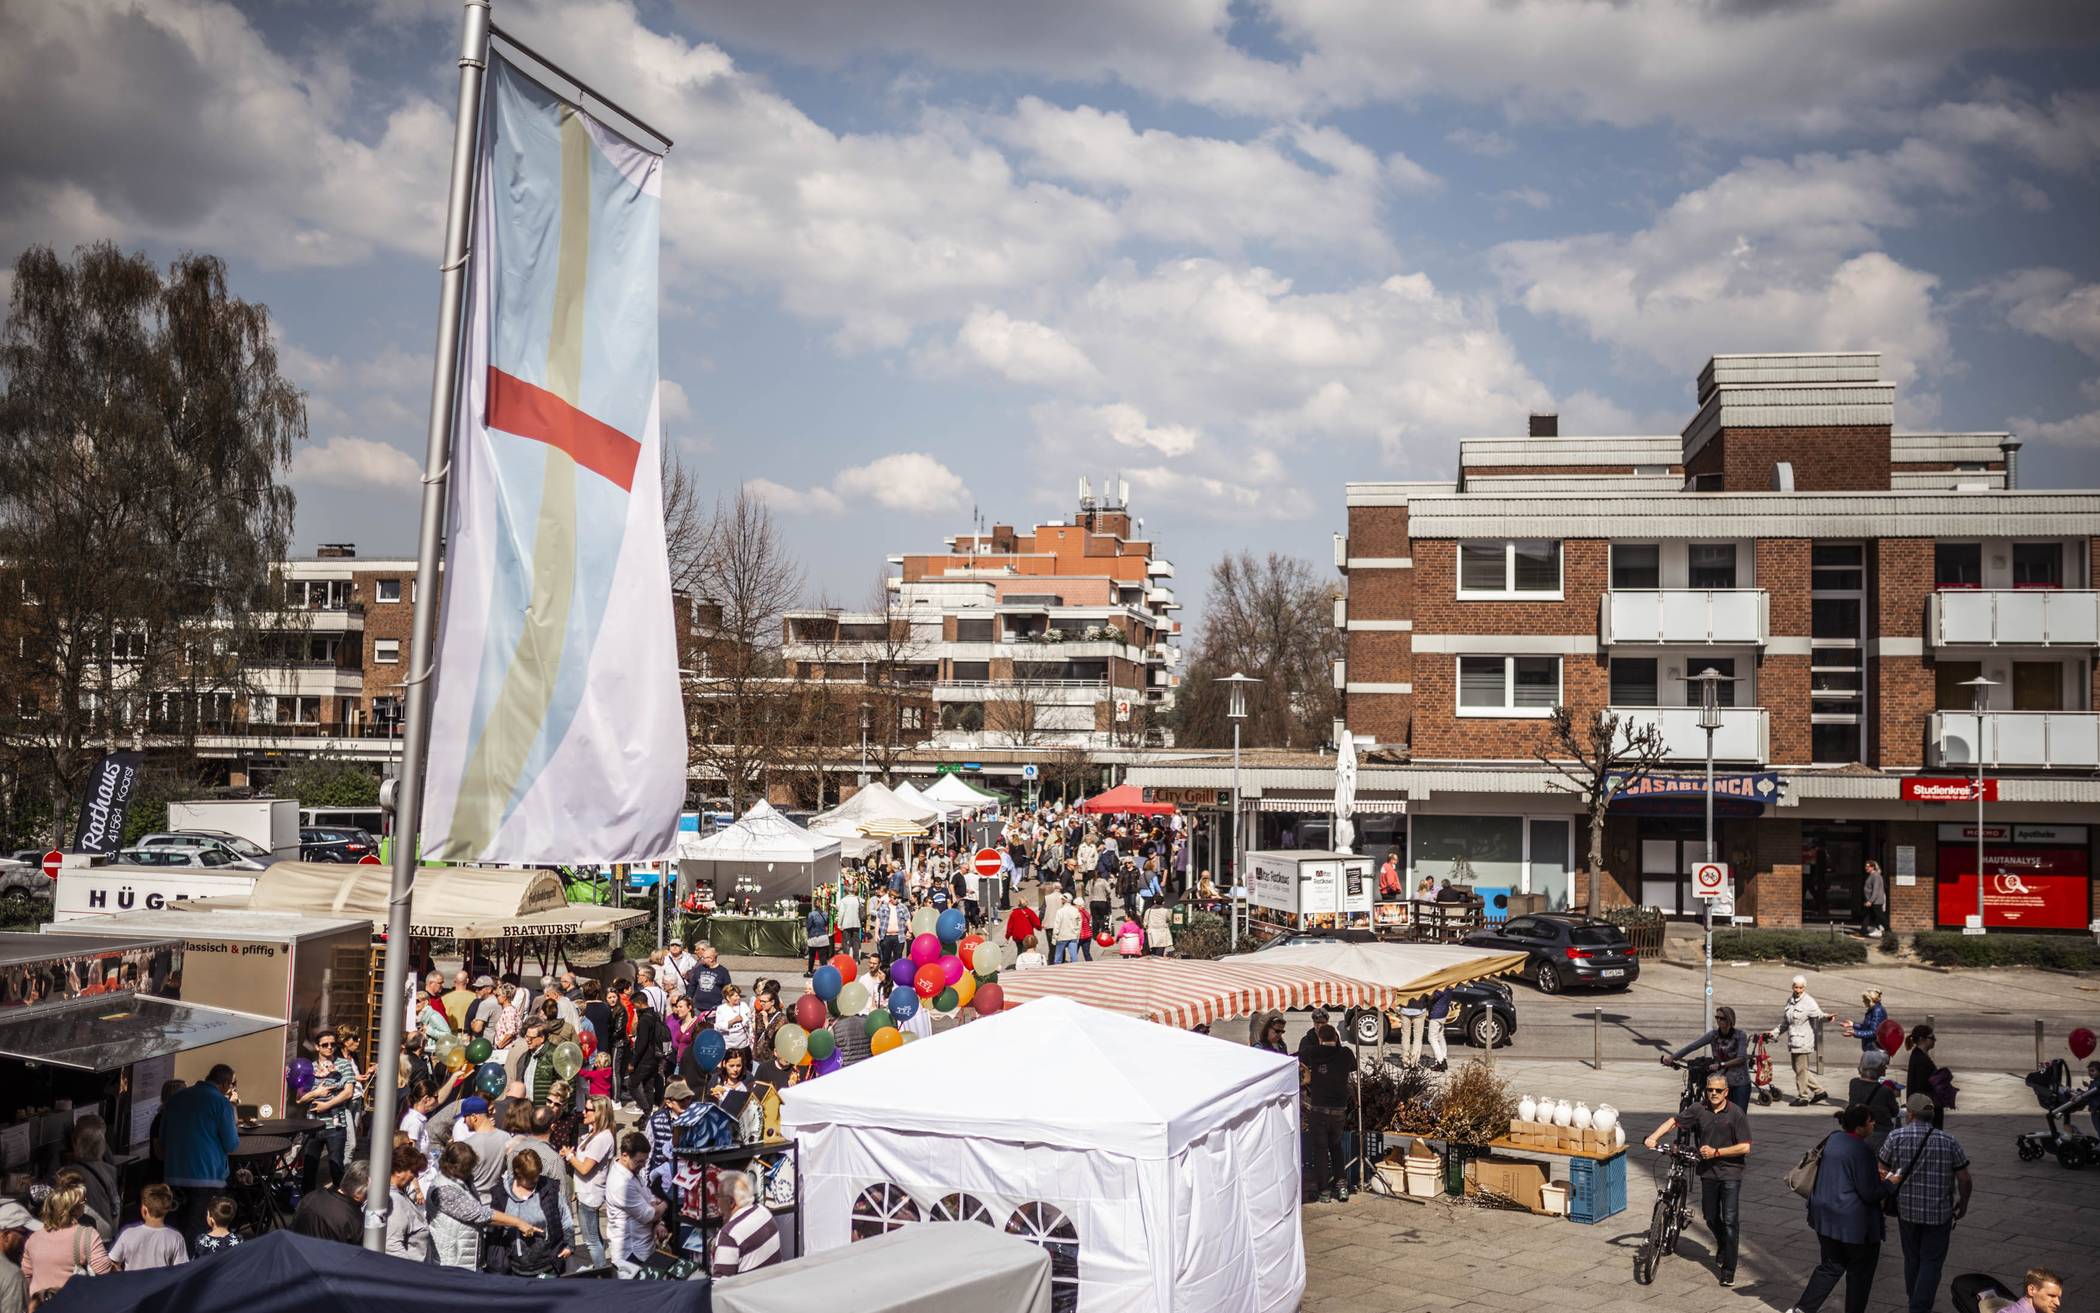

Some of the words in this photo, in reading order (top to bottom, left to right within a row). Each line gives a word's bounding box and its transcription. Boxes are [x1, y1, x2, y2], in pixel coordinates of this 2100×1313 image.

[1626, 776, 1755, 797] CASABLANCA
[1156, 788, 1180, 804] City
[1184, 788, 1216, 804] Grill
[81, 760, 121, 850] Rathaus
[108, 808, 123, 843] 41564
[2018, 830, 2056, 840] Apotheke
[1982, 856, 2042, 865] HAUTANALYSE
[89, 886, 207, 911] HÜG
[502, 923, 579, 937] BRATWURST
[231, 944, 240, 954] &
[242, 945, 275, 958] pfiffig
